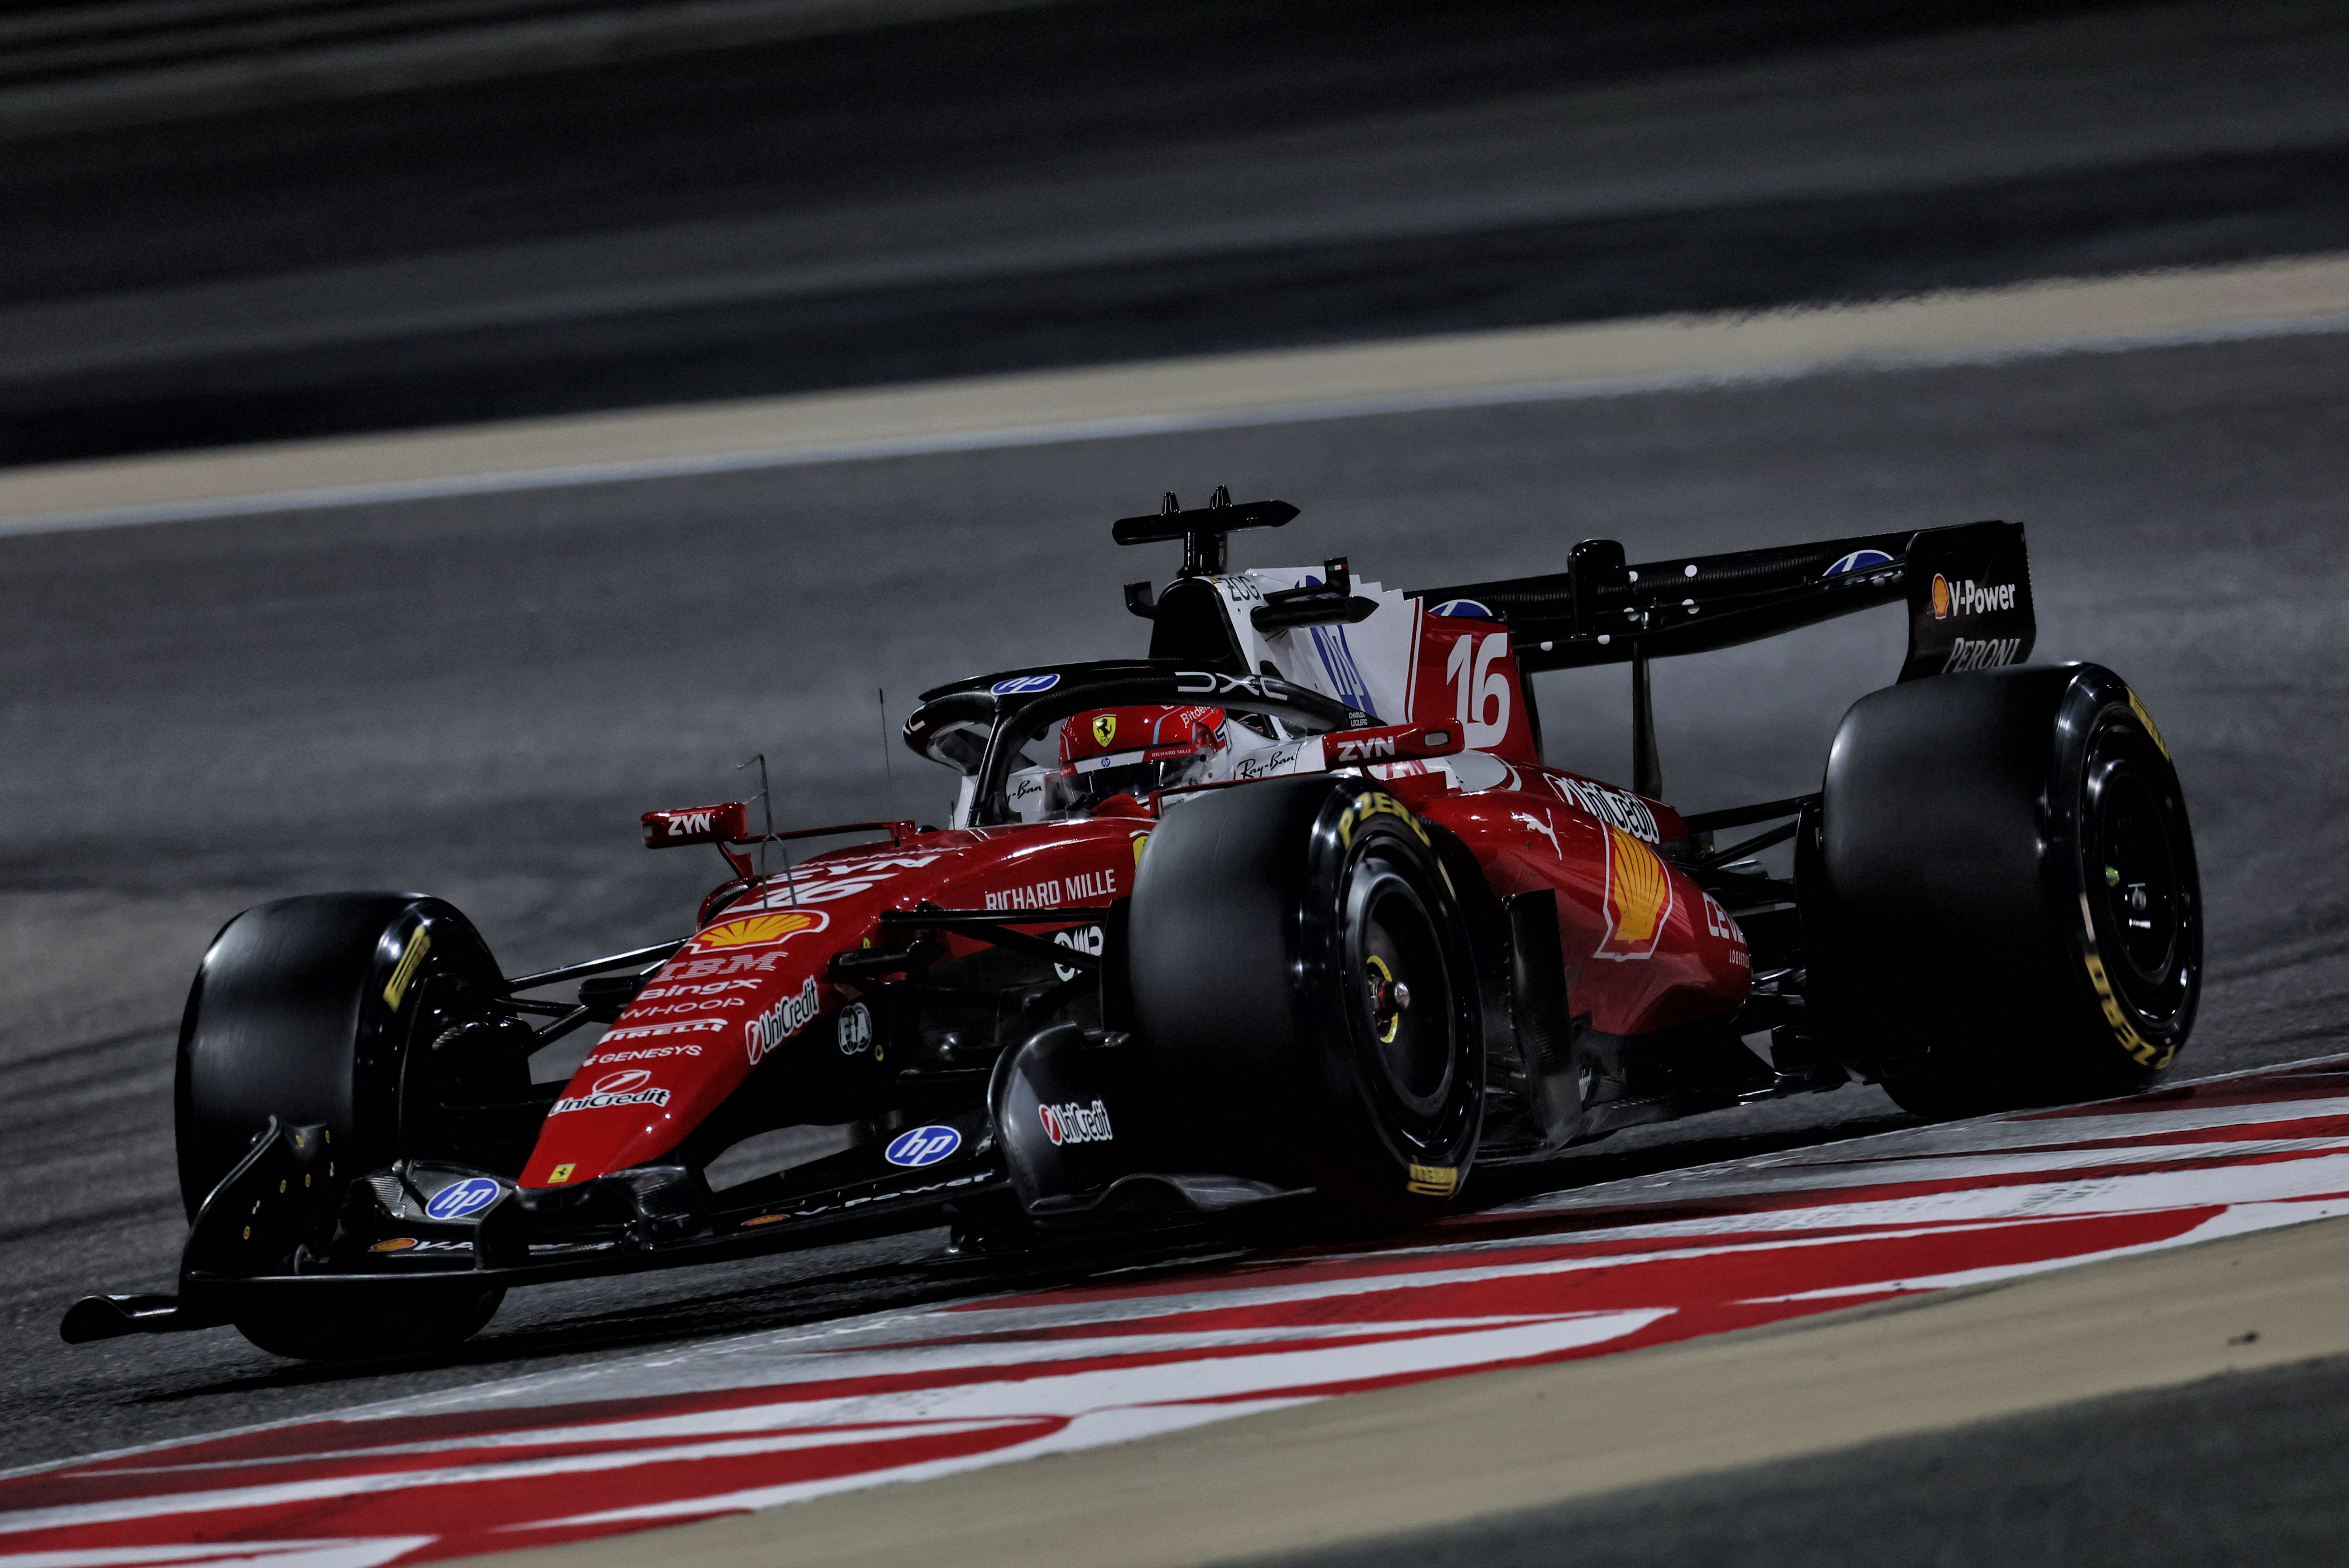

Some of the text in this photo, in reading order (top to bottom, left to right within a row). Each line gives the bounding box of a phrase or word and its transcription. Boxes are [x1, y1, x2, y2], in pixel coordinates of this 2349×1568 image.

[1948, 579, 2016, 617] V-Power
[1940, 637, 2021, 670] PERONI
[1175, 671, 1288, 701] DXC
[1446, 632, 1510, 749] 16
[1351, 718, 1368, 727] LECLERC
[1337, 735, 1396, 762] ZYN
[1237, 751, 1294, 779] Ray-Ban
[668, 812, 711, 836] ZYN
[985, 868, 1117, 910] RICHARD MILLE
[647, 951, 789, 985] IBM
[620, 997, 746, 1020] WHOOP
[760, 976, 818, 1051] UniCredit
[597, 1018, 728, 1045] PIRELLI
[598, 1045, 703, 1064] GENESYS
[550, 1089, 670, 1116] UniCredit
[1052, 1101, 1112, 1142] UniCredit
[892, 1126, 955, 1165] hp
[431, 1179, 494, 1219] hp
